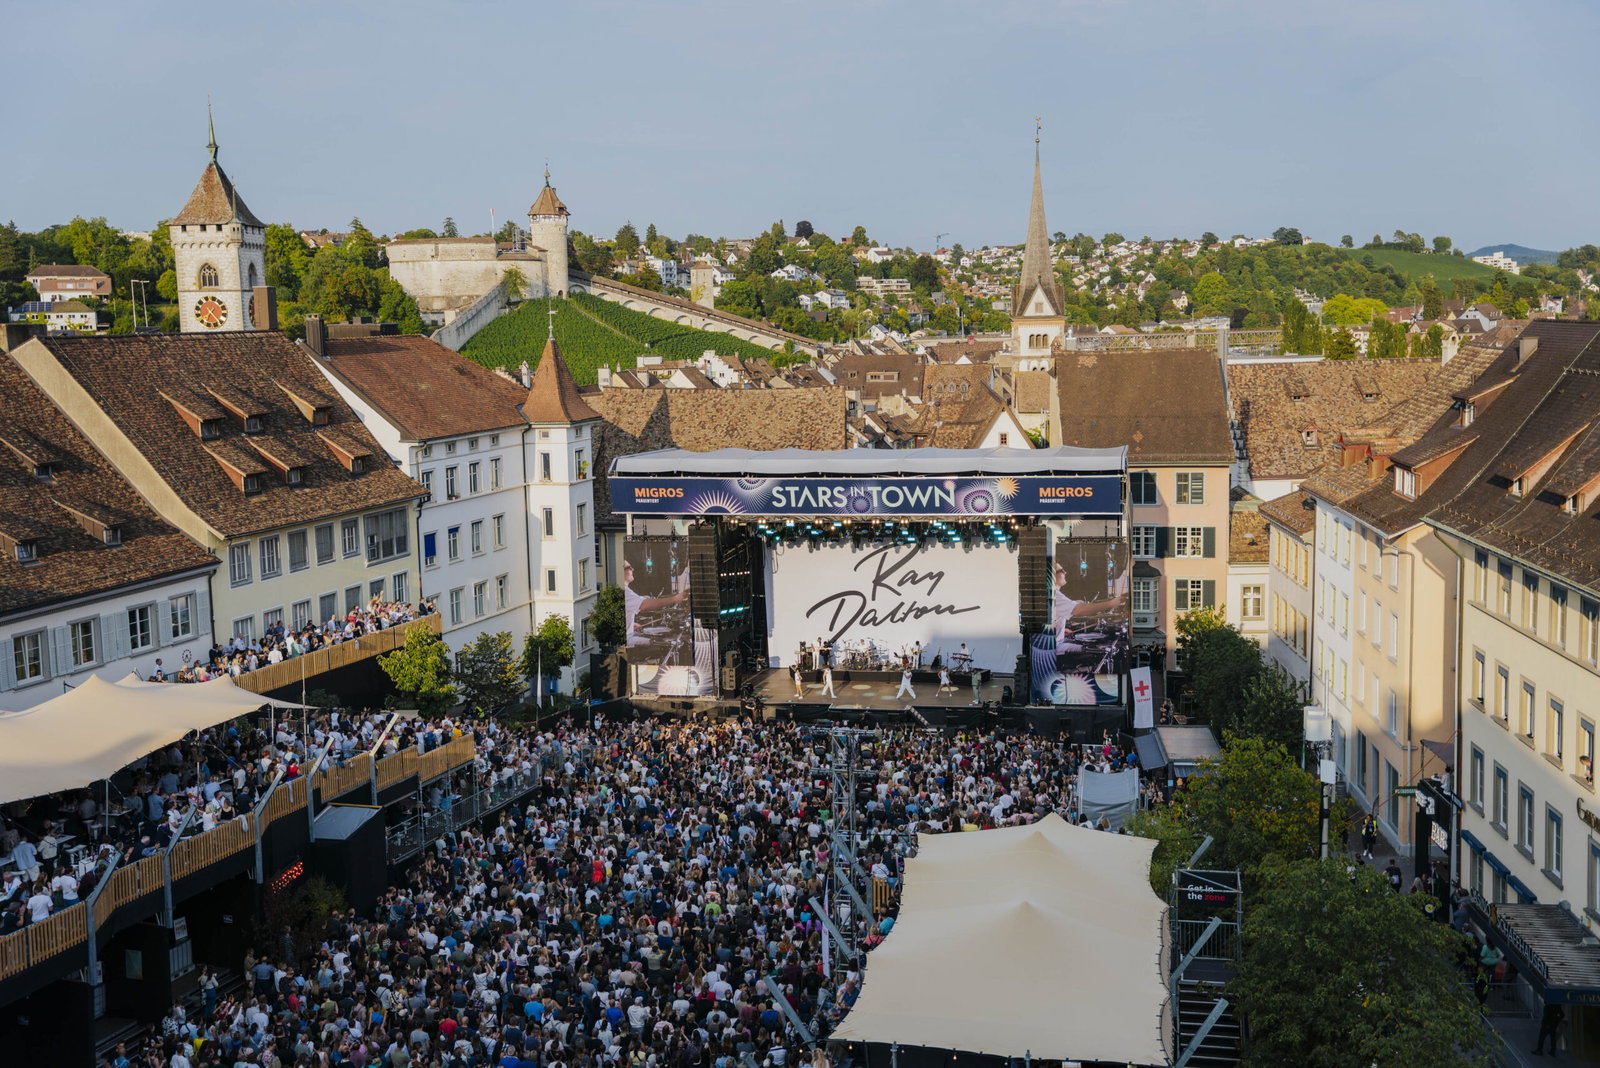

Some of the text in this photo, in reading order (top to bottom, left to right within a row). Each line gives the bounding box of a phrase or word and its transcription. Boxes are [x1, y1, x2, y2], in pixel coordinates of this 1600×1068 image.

[634, 487, 685, 498] MIGROS
[771, 485, 956, 508] STARS IN TOWN
[1039, 487, 1094, 498] MIGROS
[853, 541, 945, 602] Ray
[805, 590, 981, 644] Dalton
[1187, 884, 1204, 892] Get
[1187, 892, 1203, 900] the
